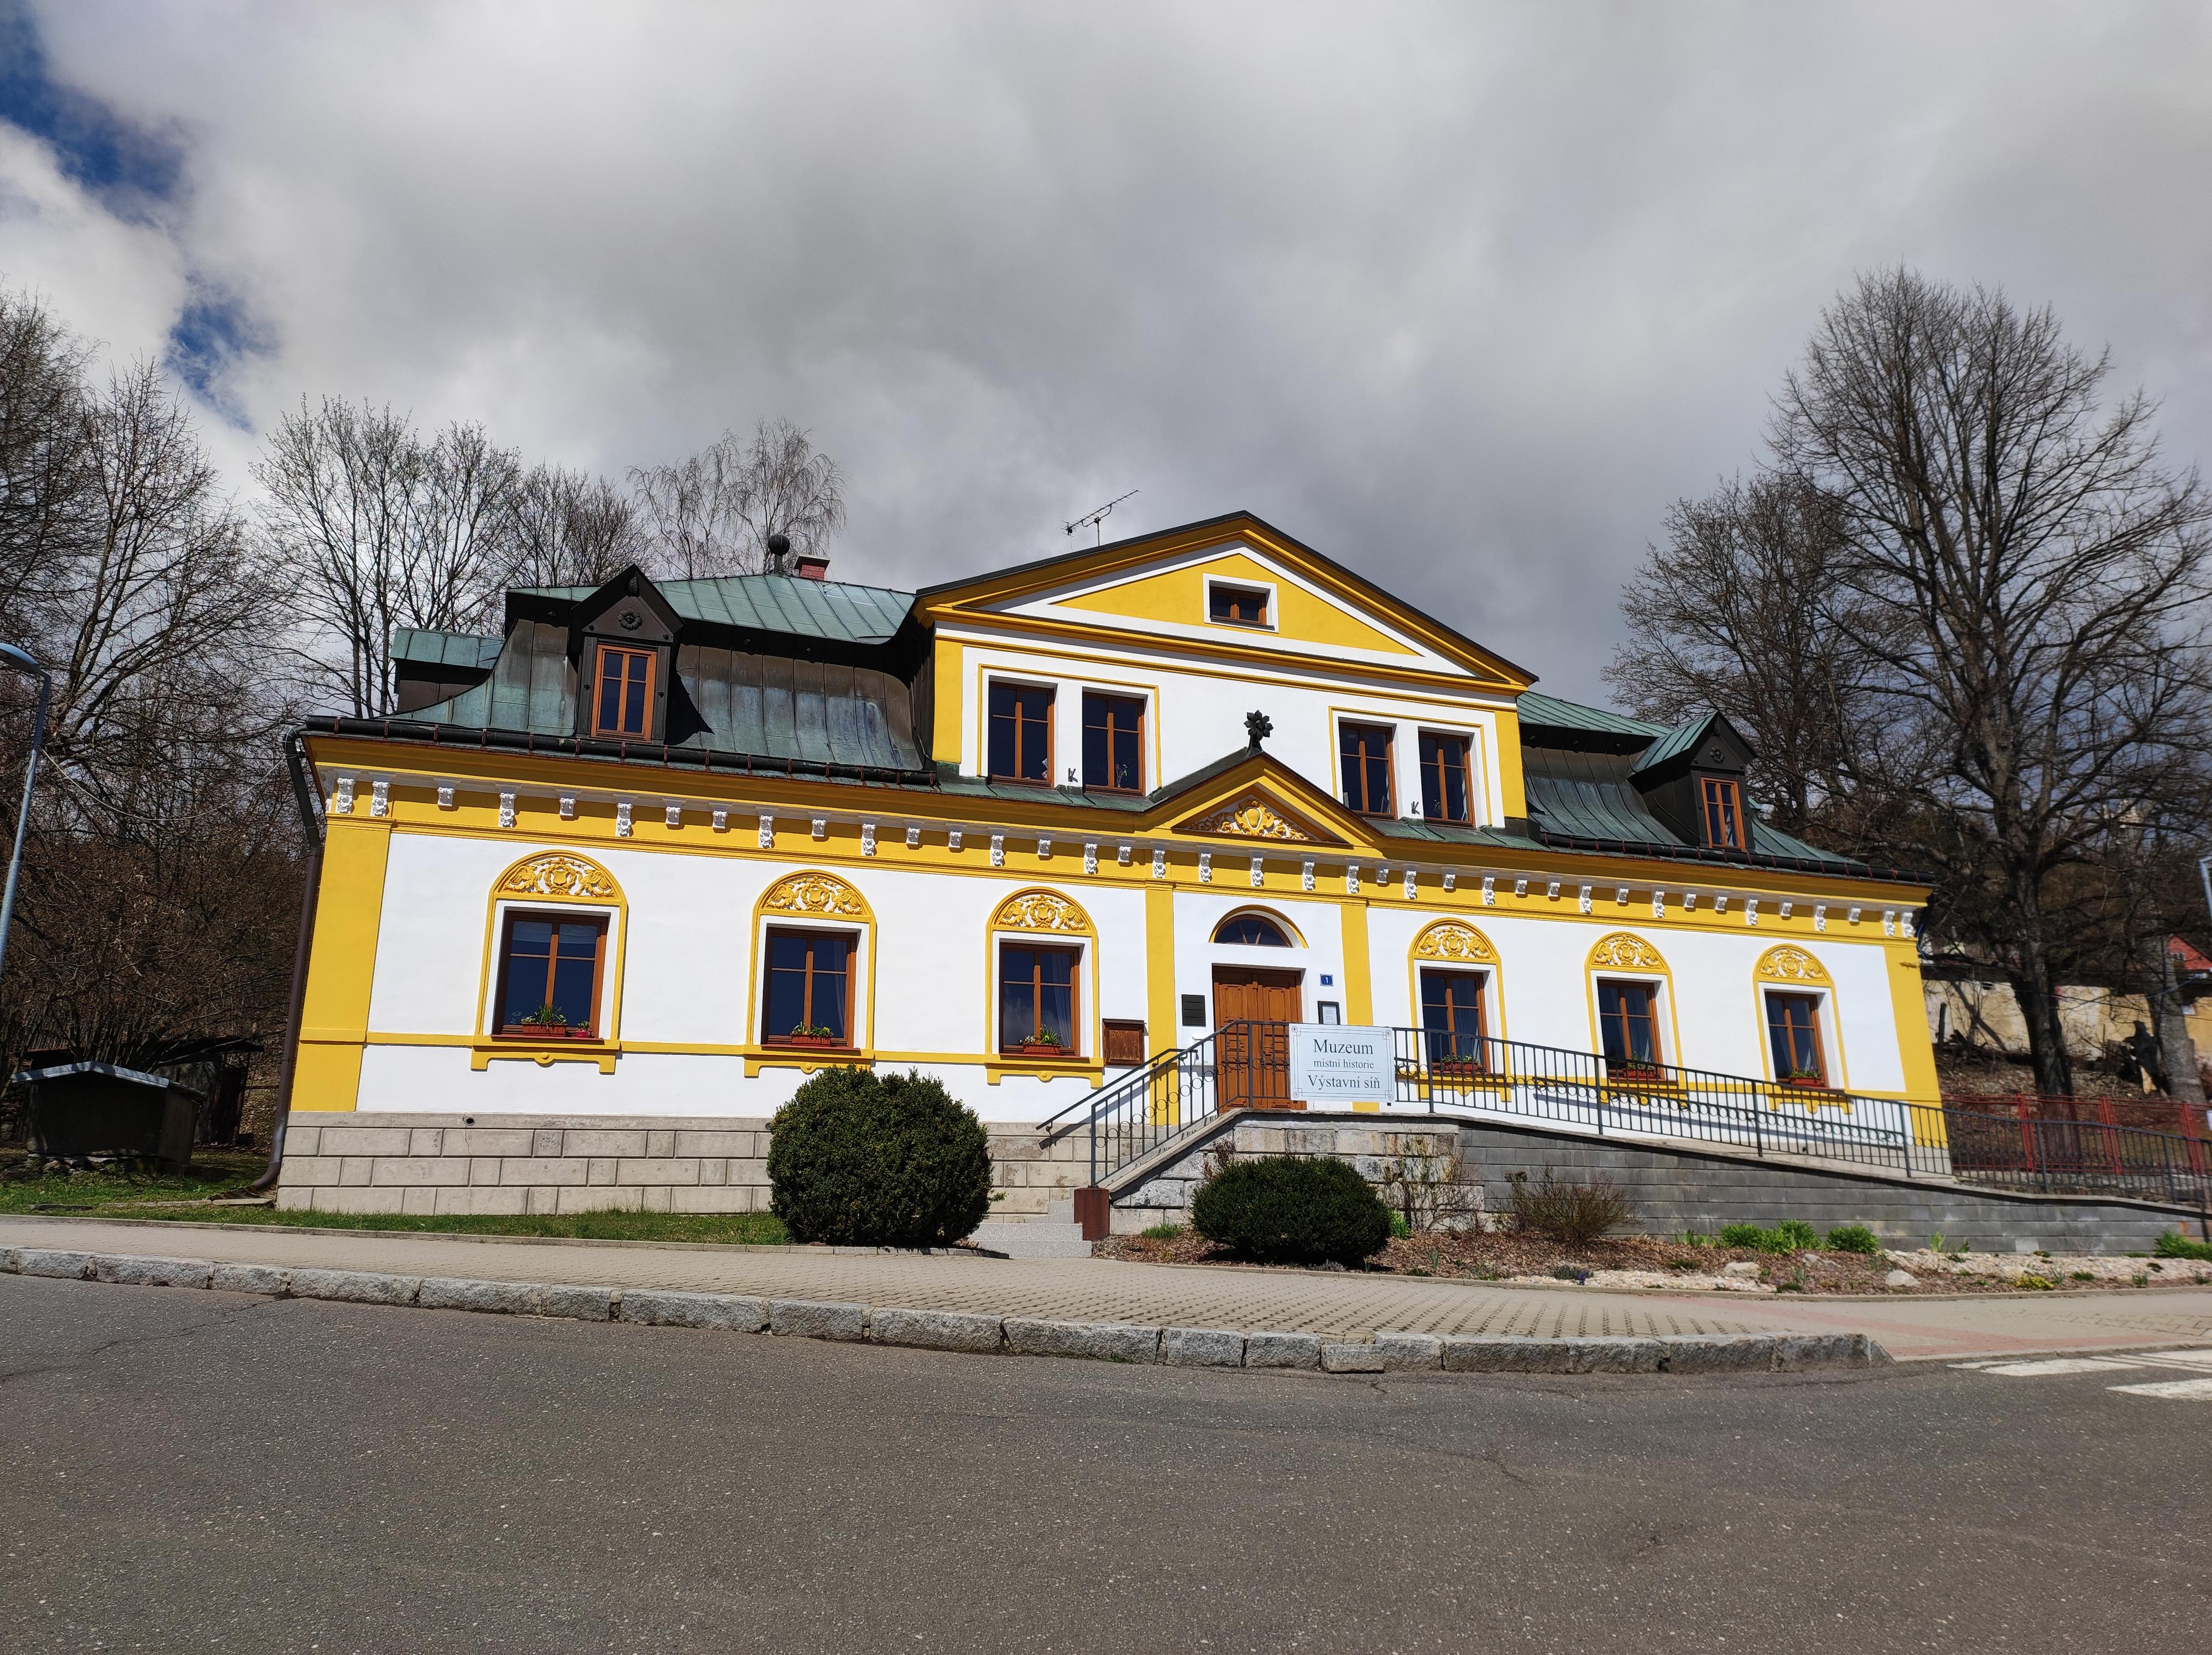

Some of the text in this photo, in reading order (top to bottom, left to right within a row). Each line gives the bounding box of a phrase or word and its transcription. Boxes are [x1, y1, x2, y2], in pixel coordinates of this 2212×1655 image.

[1313, 1038, 1374, 1055] Muzeum
[1313, 1058, 1374, 1069] místní historie
[1308, 1074, 1380, 1090] Výstavní síň
